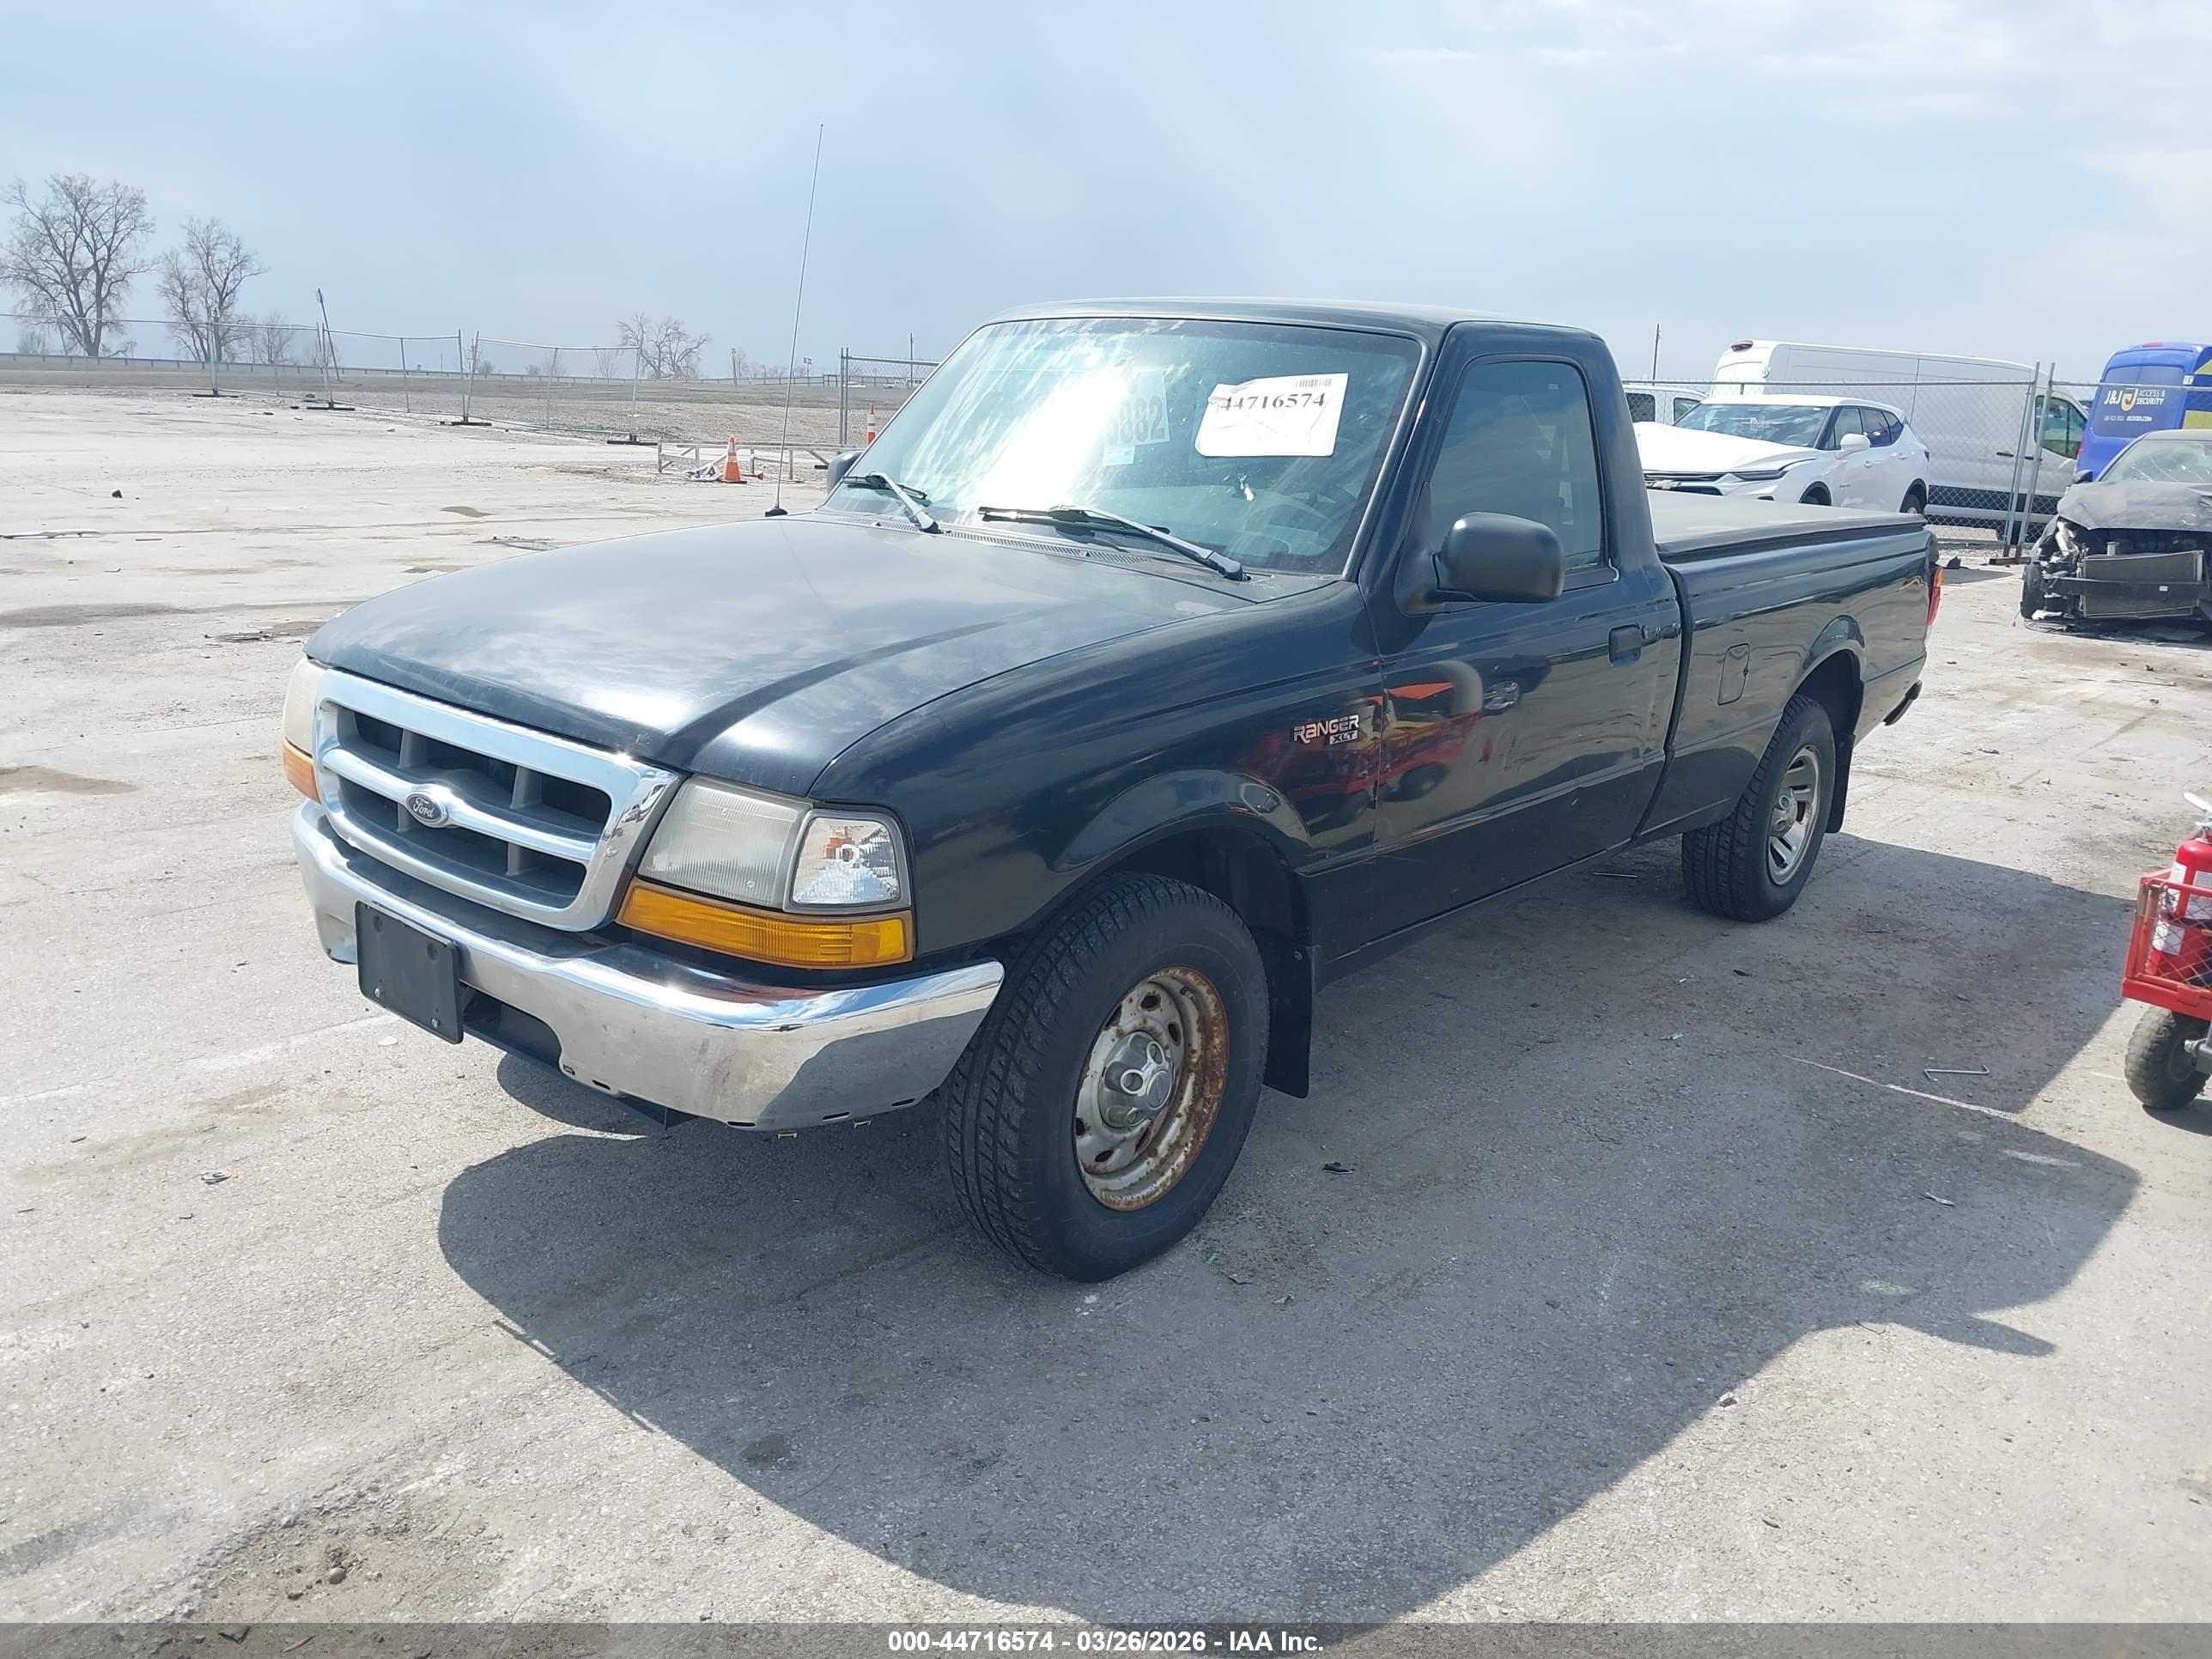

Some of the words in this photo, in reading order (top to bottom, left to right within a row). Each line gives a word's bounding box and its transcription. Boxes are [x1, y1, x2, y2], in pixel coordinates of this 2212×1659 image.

[1219, 392, 1326, 410] 44716574
[2104, 390, 2124, 404] J&J
[1293, 714, 1359, 744] RANGER
[1330, 731, 1358, 744] XLT
[413, 797, 434, 818] Ford
